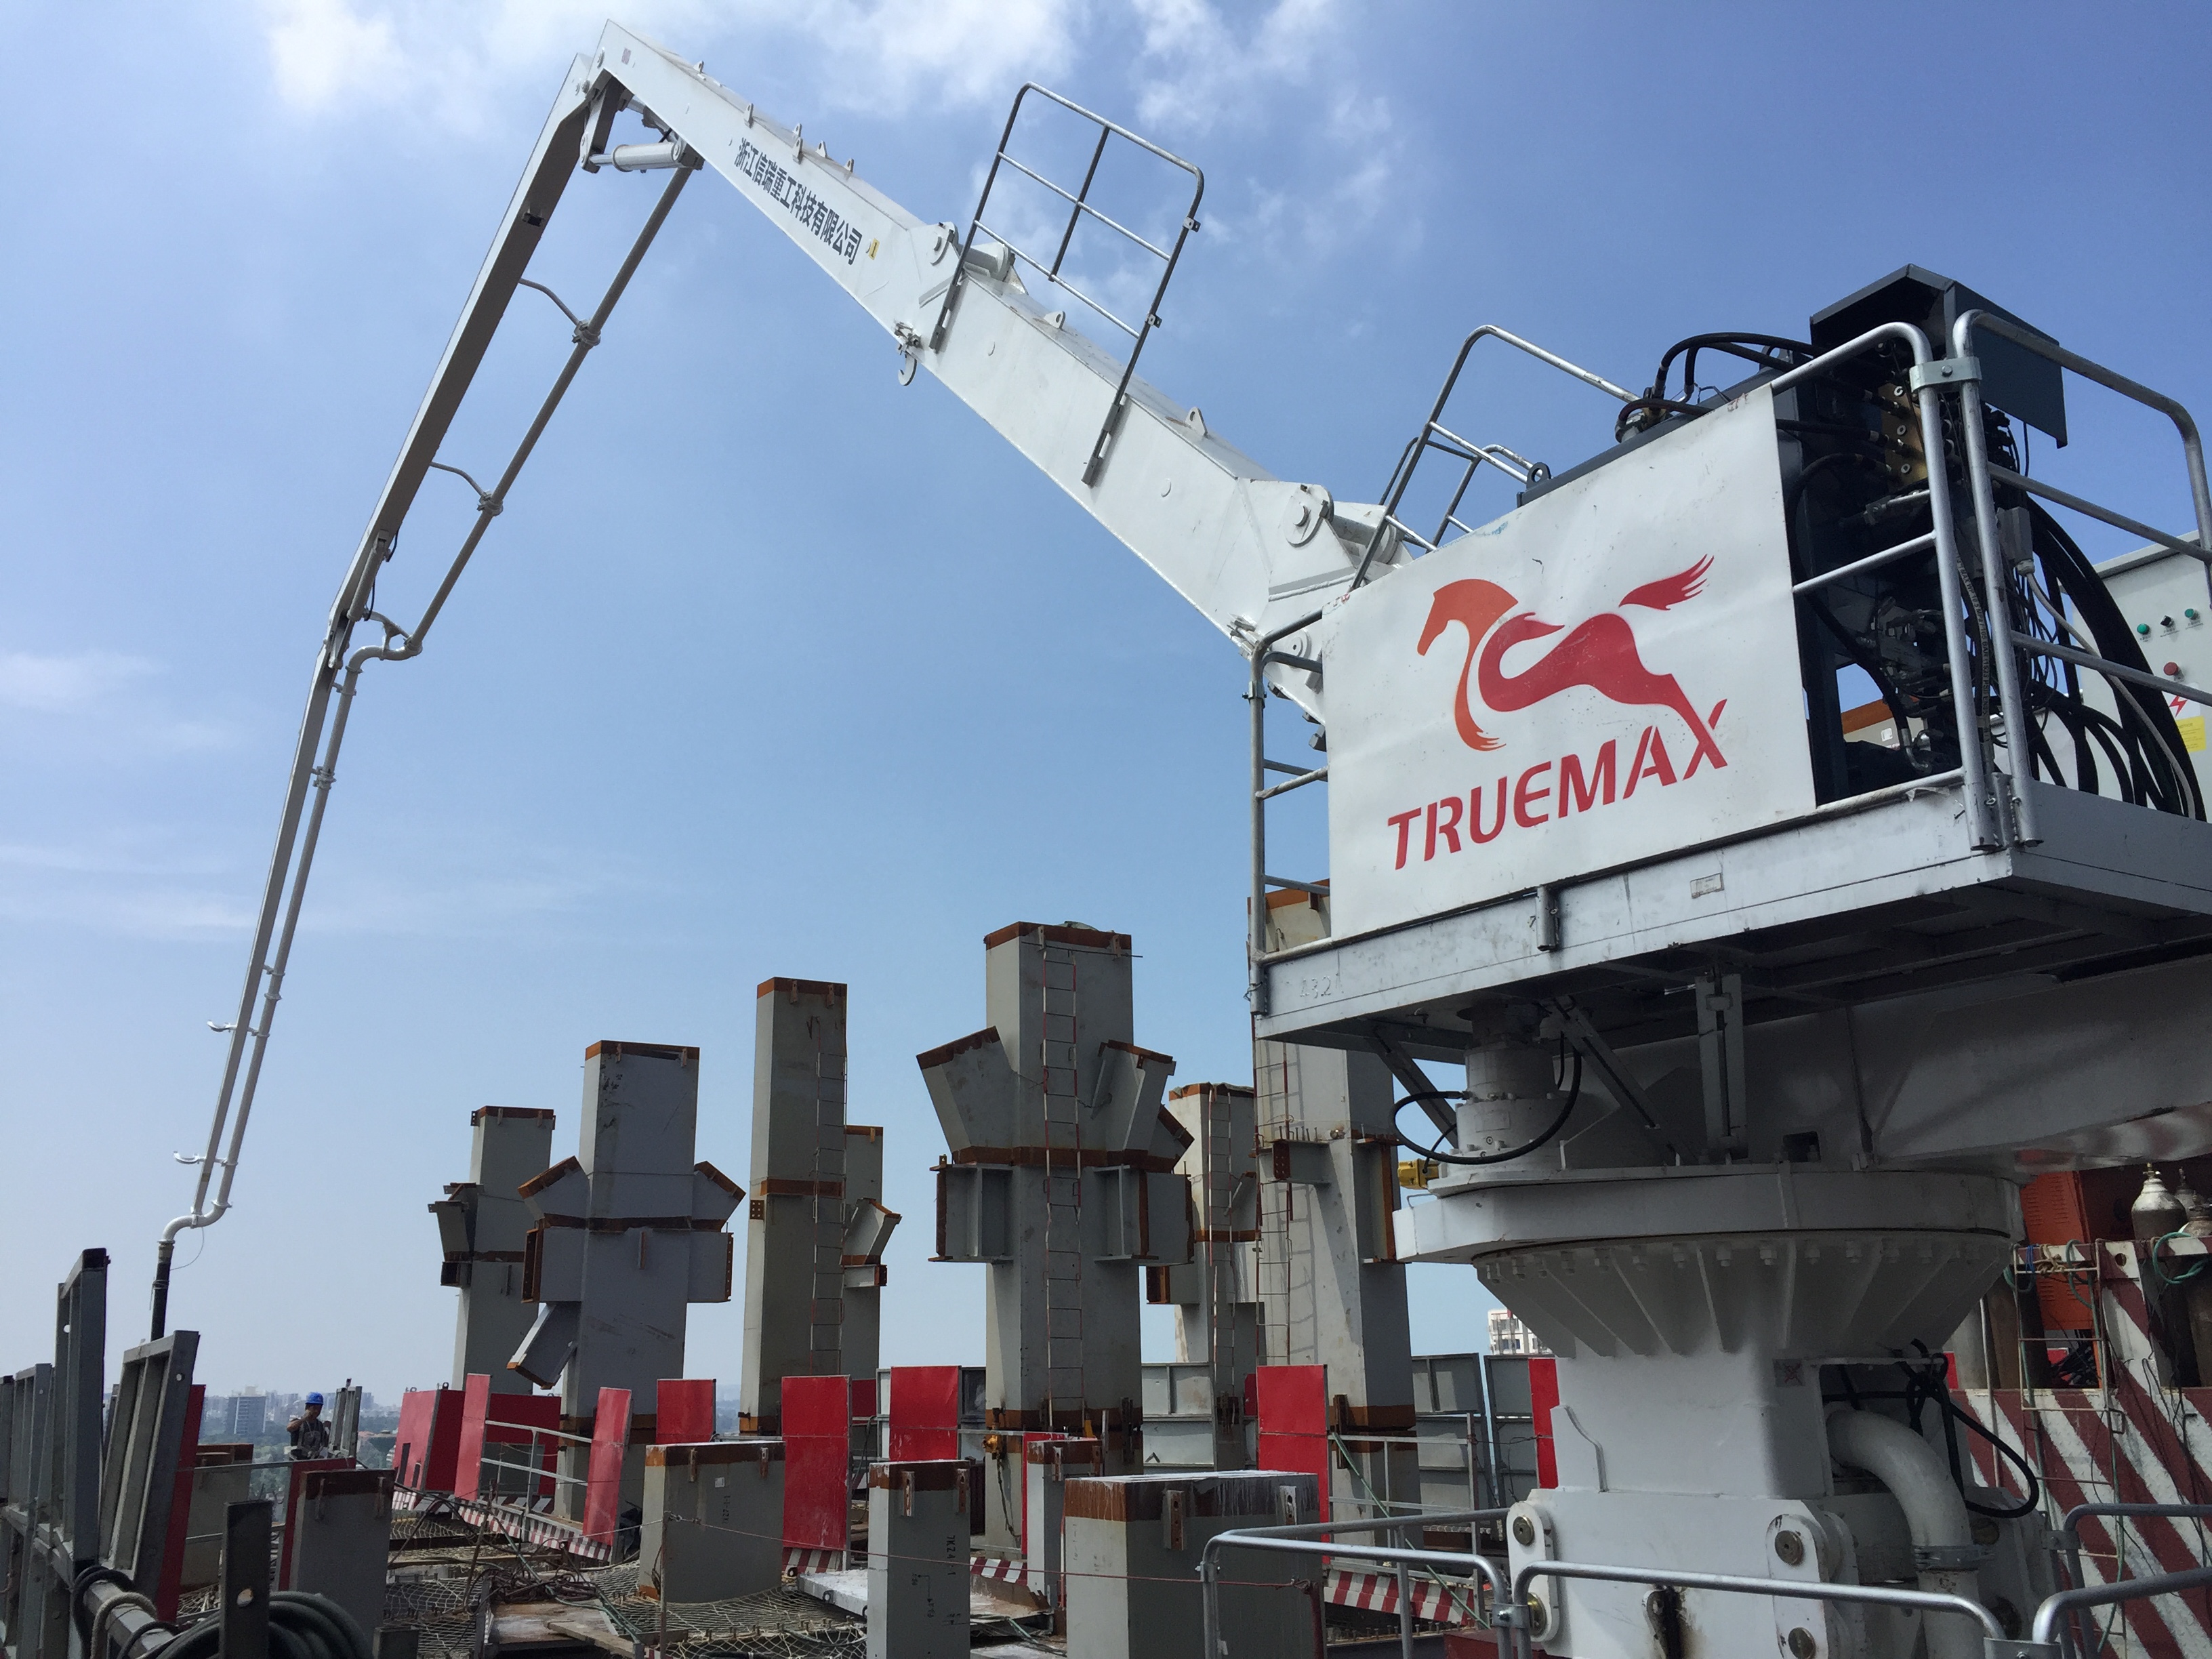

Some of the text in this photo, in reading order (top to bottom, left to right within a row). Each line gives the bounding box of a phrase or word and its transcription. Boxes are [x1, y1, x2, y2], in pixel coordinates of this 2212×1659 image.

[734, 137, 863, 266] 浙江信瑞重工科技有限公司
[1387, 698, 1728, 870] TRUEMAX
